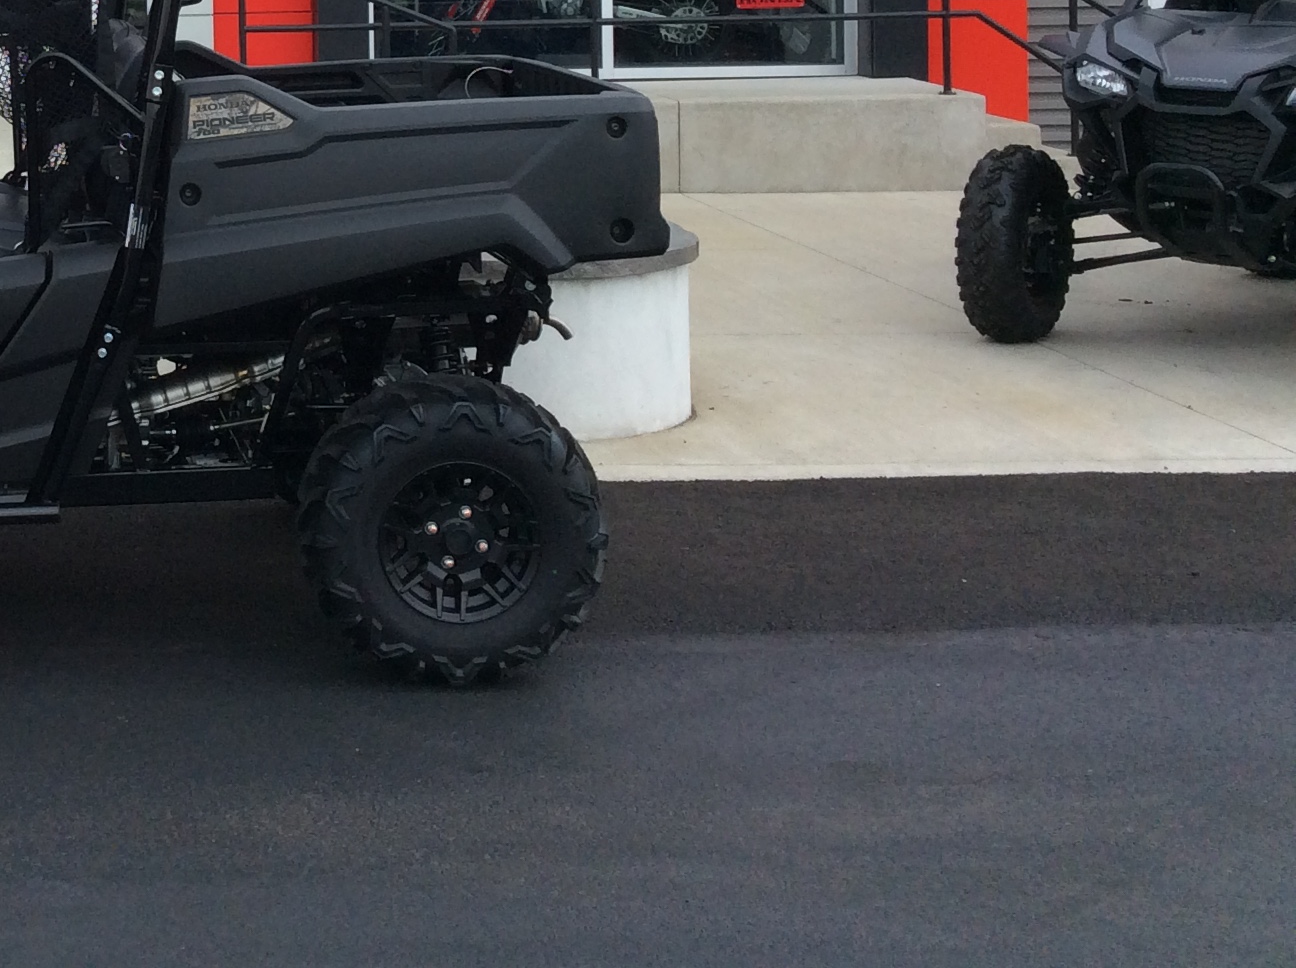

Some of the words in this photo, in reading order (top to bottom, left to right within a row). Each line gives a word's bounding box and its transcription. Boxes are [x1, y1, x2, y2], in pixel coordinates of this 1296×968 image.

[196, 99, 251, 113] HONDA
[192, 112, 275, 129] PIONEER
[196, 127, 221, 136] 700
